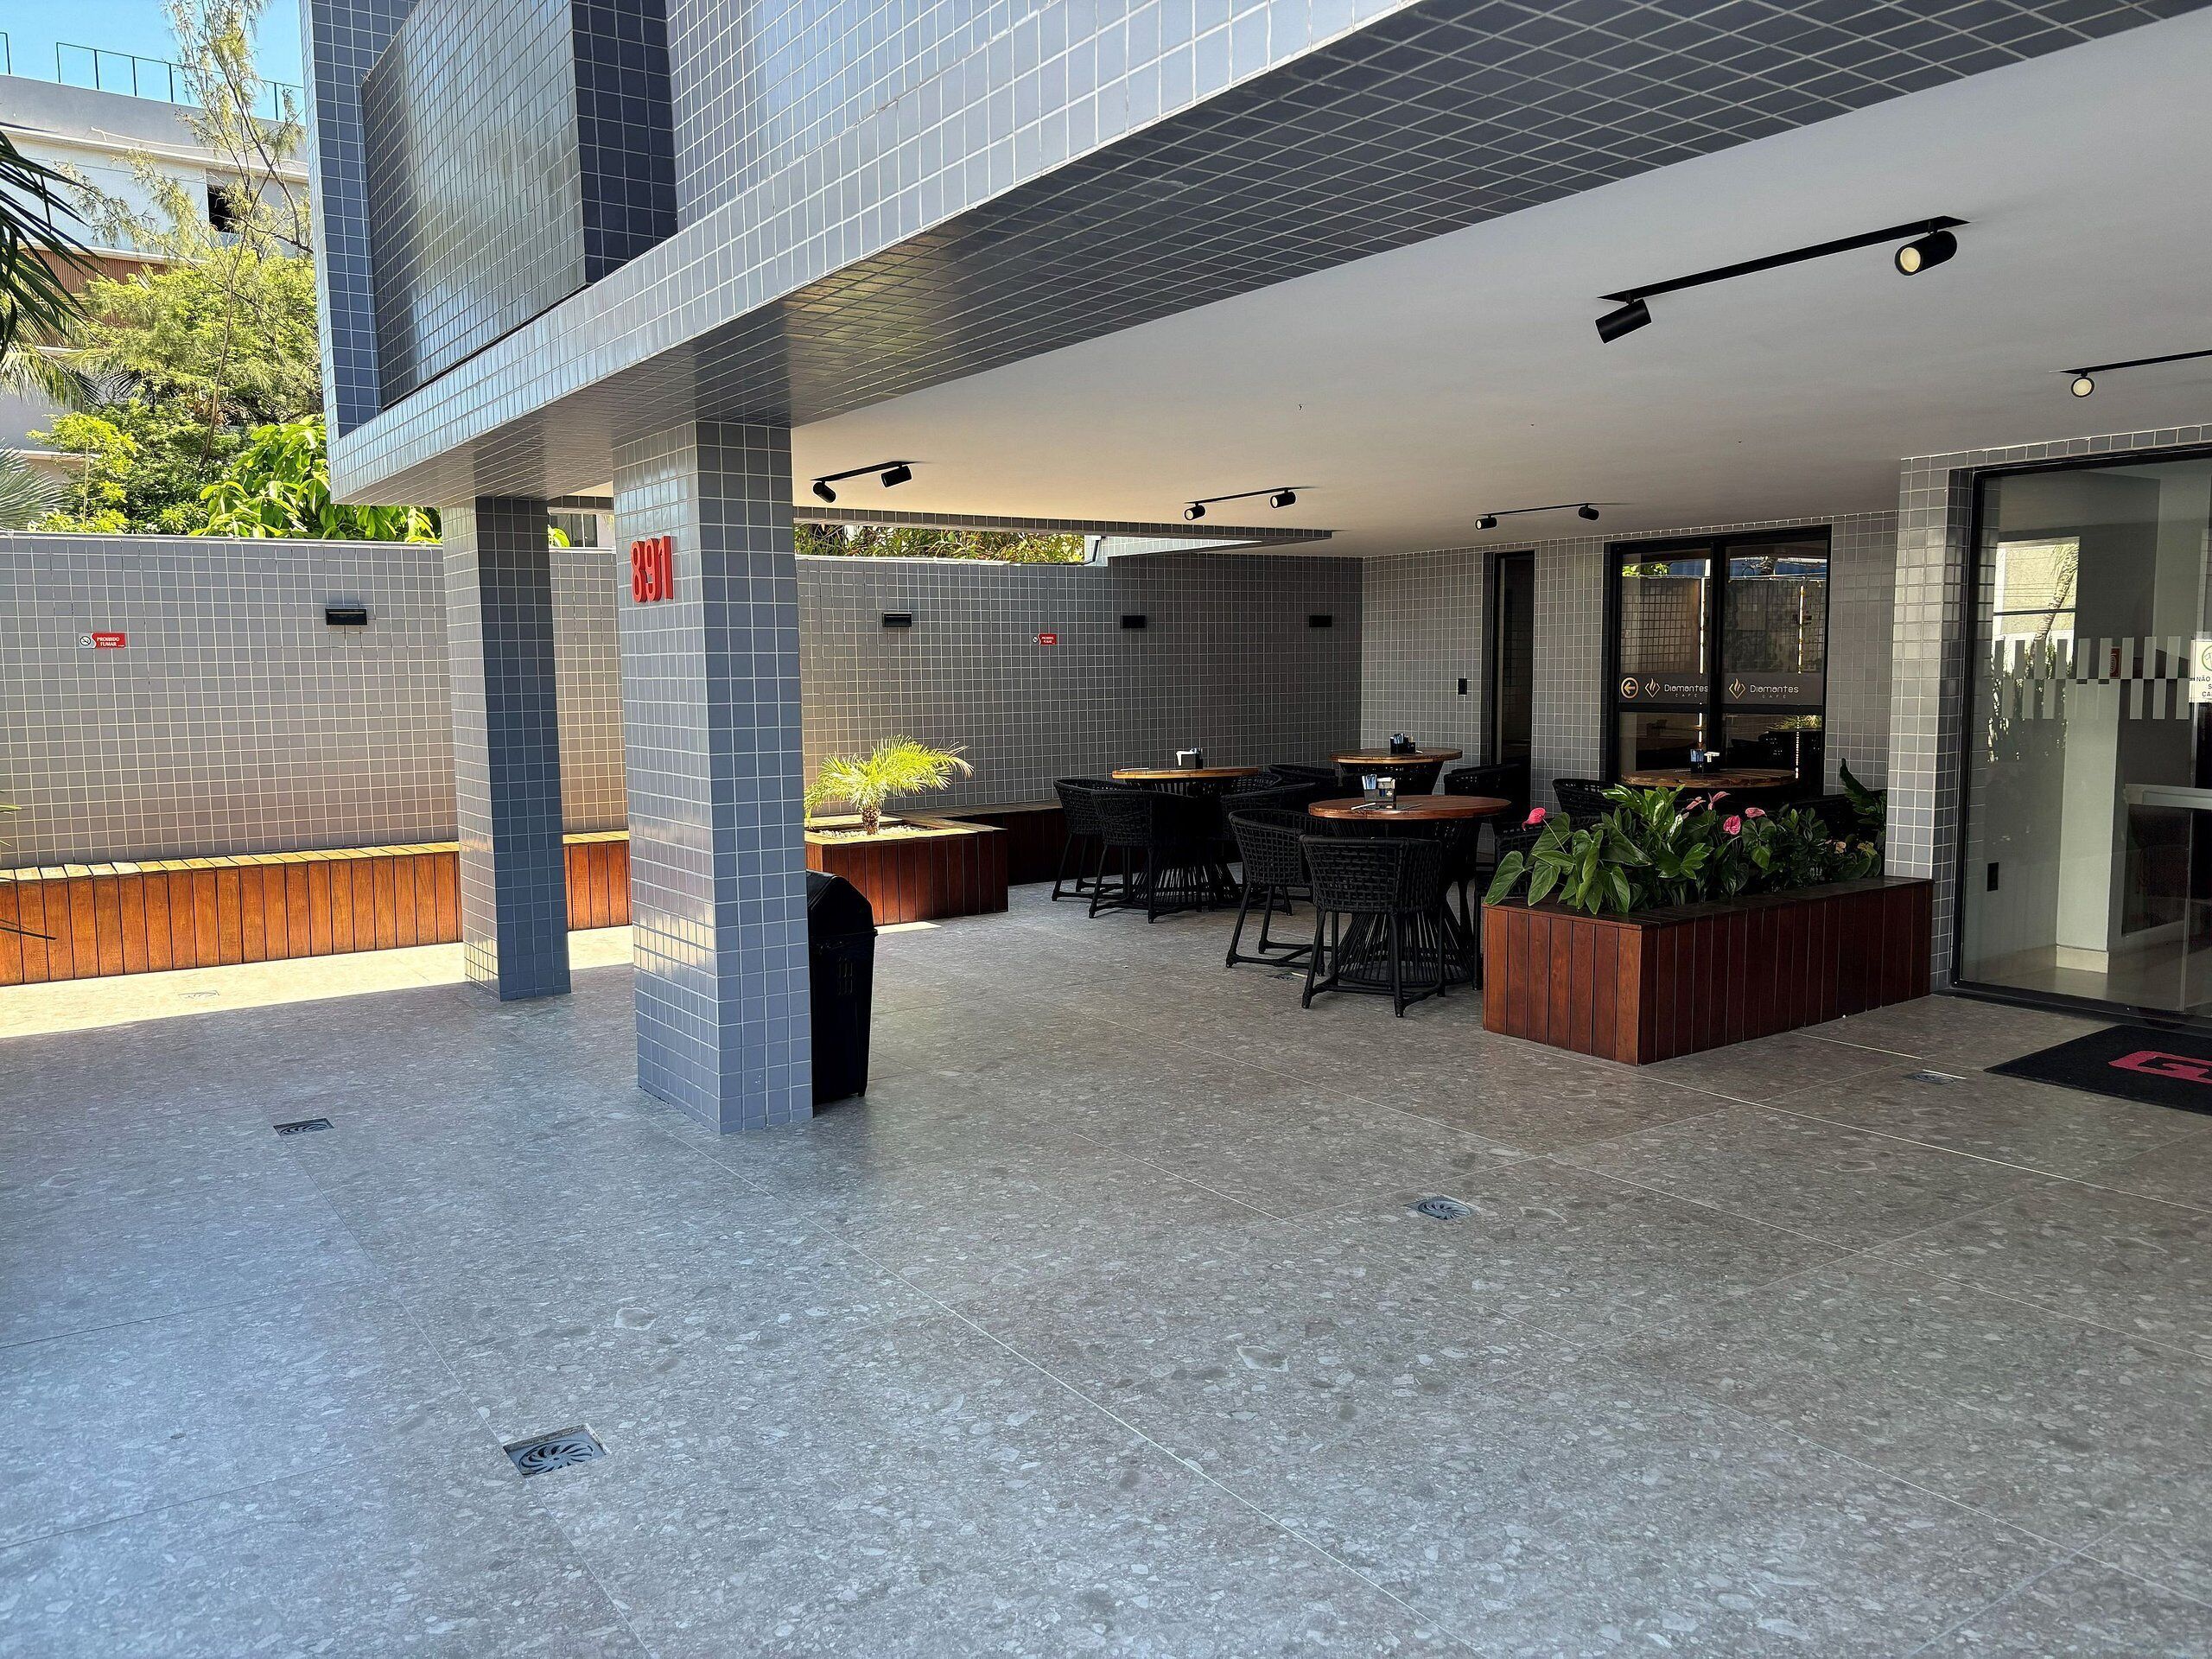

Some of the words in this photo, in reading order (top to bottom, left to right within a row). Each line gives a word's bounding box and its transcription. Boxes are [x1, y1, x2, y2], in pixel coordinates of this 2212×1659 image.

[631, 535, 674, 603] 891
[1664, 683, 1708, 692] Diamantes
[1750, 684, 1799, 693] Diamantes
